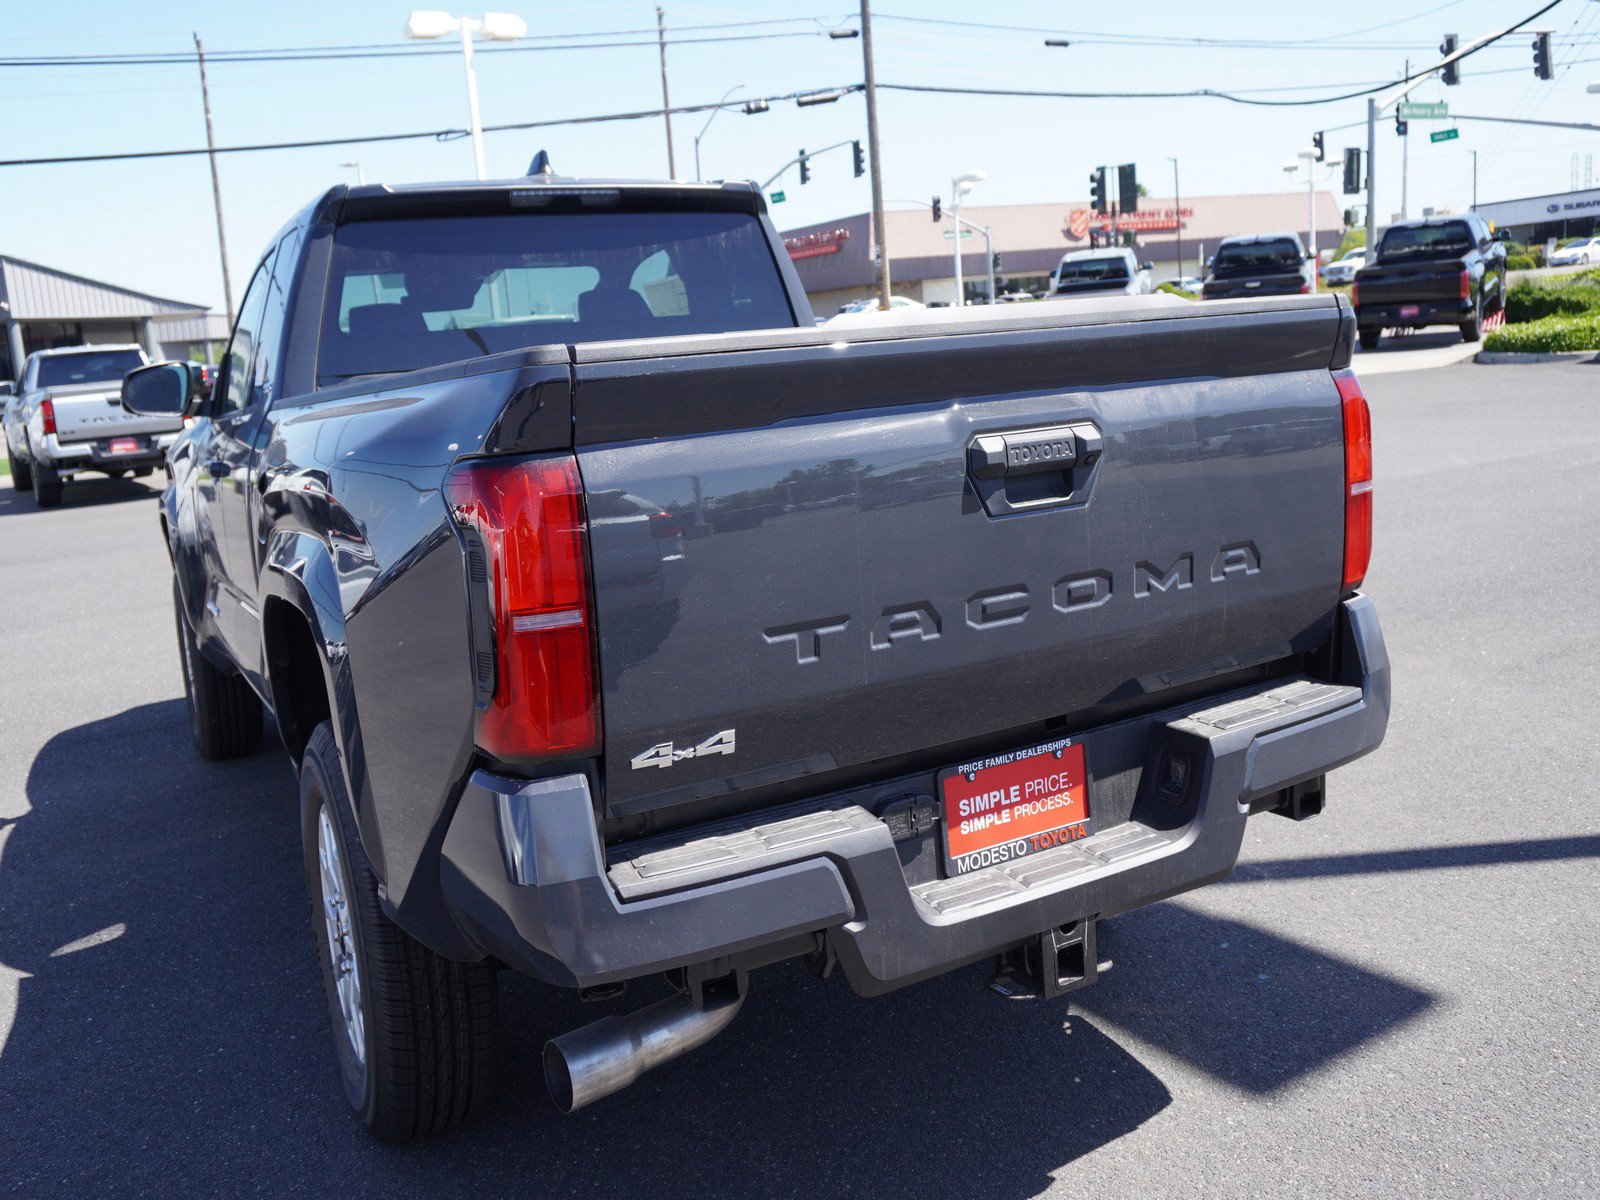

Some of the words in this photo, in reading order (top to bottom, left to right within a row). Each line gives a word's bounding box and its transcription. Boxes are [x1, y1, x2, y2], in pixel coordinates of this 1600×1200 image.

[1010, 441, 1074, 463] TOYOTA
[762, 539, 1262, 665] TACOMA
[958, 762, 983, 774] PRICE
[985, 753, 1014, 768] FAMILY
[1016, 738, 1072, 761] DEALERSHIPS
[959, 785, 1020, 817] SIMPLE
[1025, 772, 1073, 799] PRICE.
[960, 808, 1011, 835] SIMPLE
[1014, 792, 1074, 820] PROCESS.
[957, 839, 1027, 874] MODESTO
[1030, 824, 1087, 851] TOYOTA
